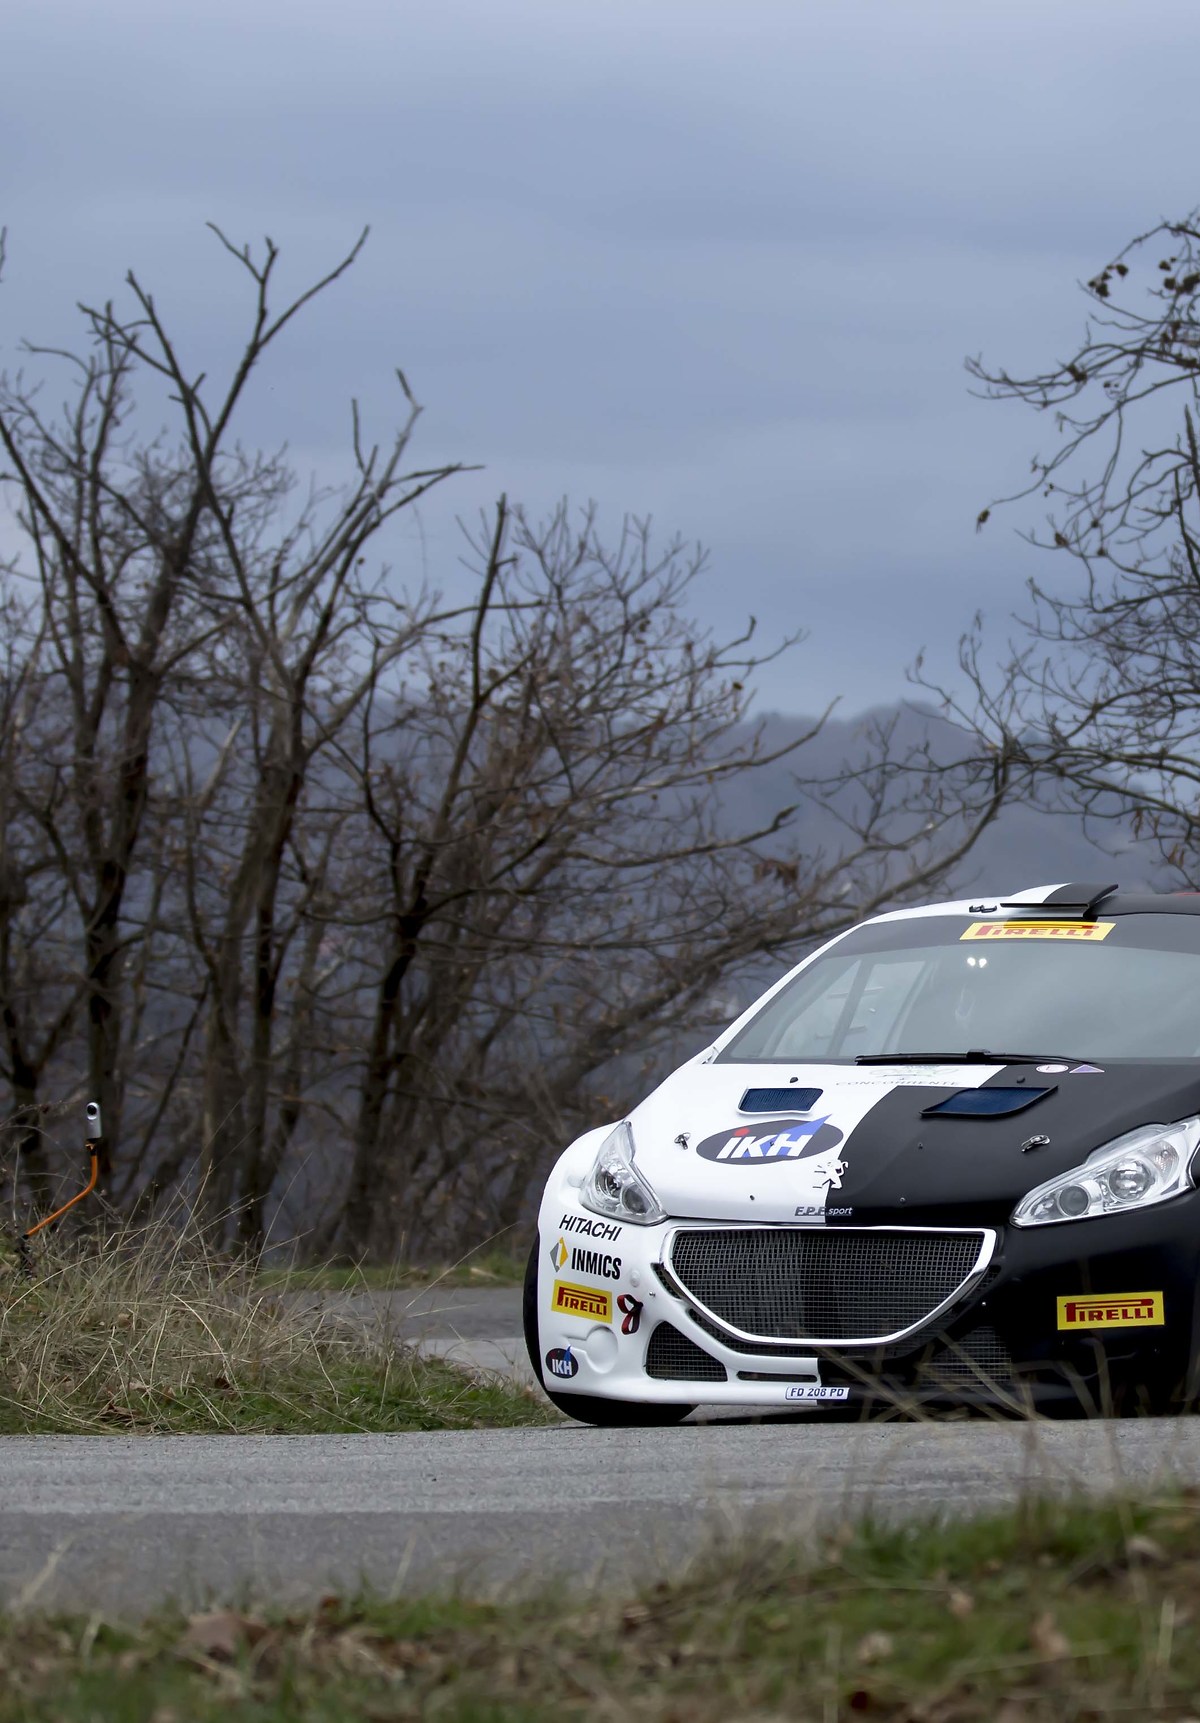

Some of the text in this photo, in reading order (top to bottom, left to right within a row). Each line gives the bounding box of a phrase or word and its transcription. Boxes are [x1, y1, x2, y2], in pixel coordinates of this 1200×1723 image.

[975, 924, 1100, 937] PIRELLI
[559, 1214, 622, 1241] HITACHI
[571, 1248, 622, 1280] INMICS
[557, 1286, 608, 1316] PIRELLI
[1064, 1298, 1154, 1322] PIRELLI
[551, 1357, 573, 1376] IKH
[790, 1387, 845, 1397] FD 208 PD
